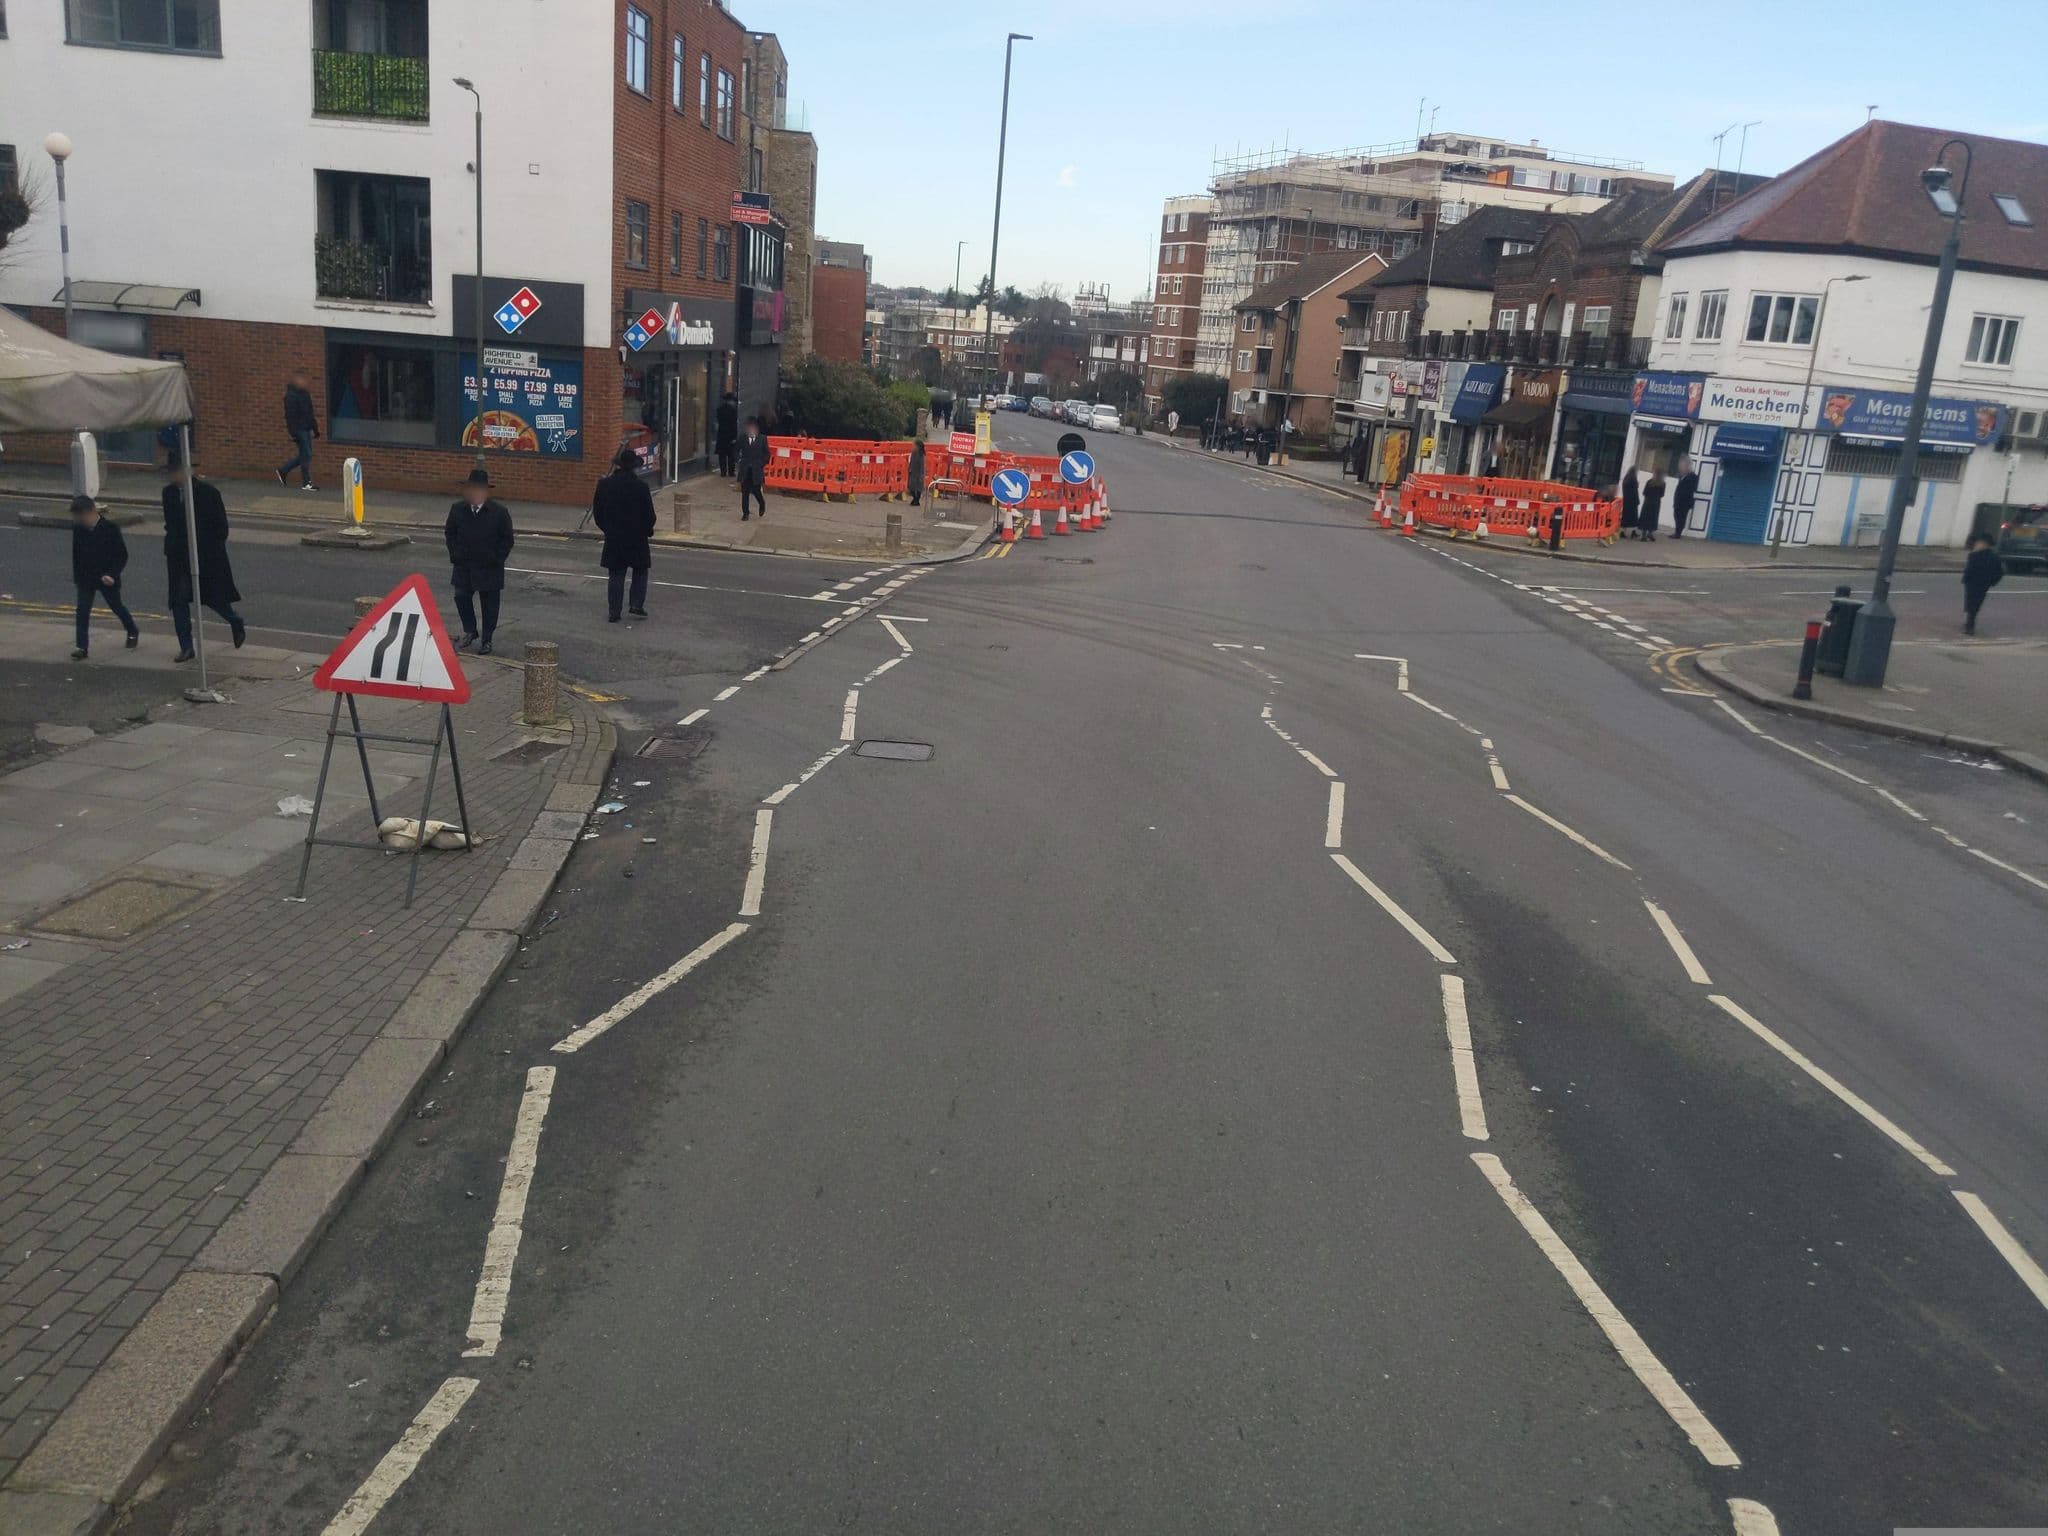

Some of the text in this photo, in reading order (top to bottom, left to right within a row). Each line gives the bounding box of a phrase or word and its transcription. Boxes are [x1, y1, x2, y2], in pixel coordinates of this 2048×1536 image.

[680, 320, 714, 345] Domino's
[484, 350, 522, 360] HIGHFIELD
[485, 357, 513, 366] AVENUE
[464, 376, 577, 395] £3.9 £5.99 £7.99 £9.99
[1522, 382, 1550, 398] TABOON
[1648, 379, 1687, 396] Menachems
[1710, 393, 1809, 416] Menachems
[1866, 399, 1968, 423] Menahems
